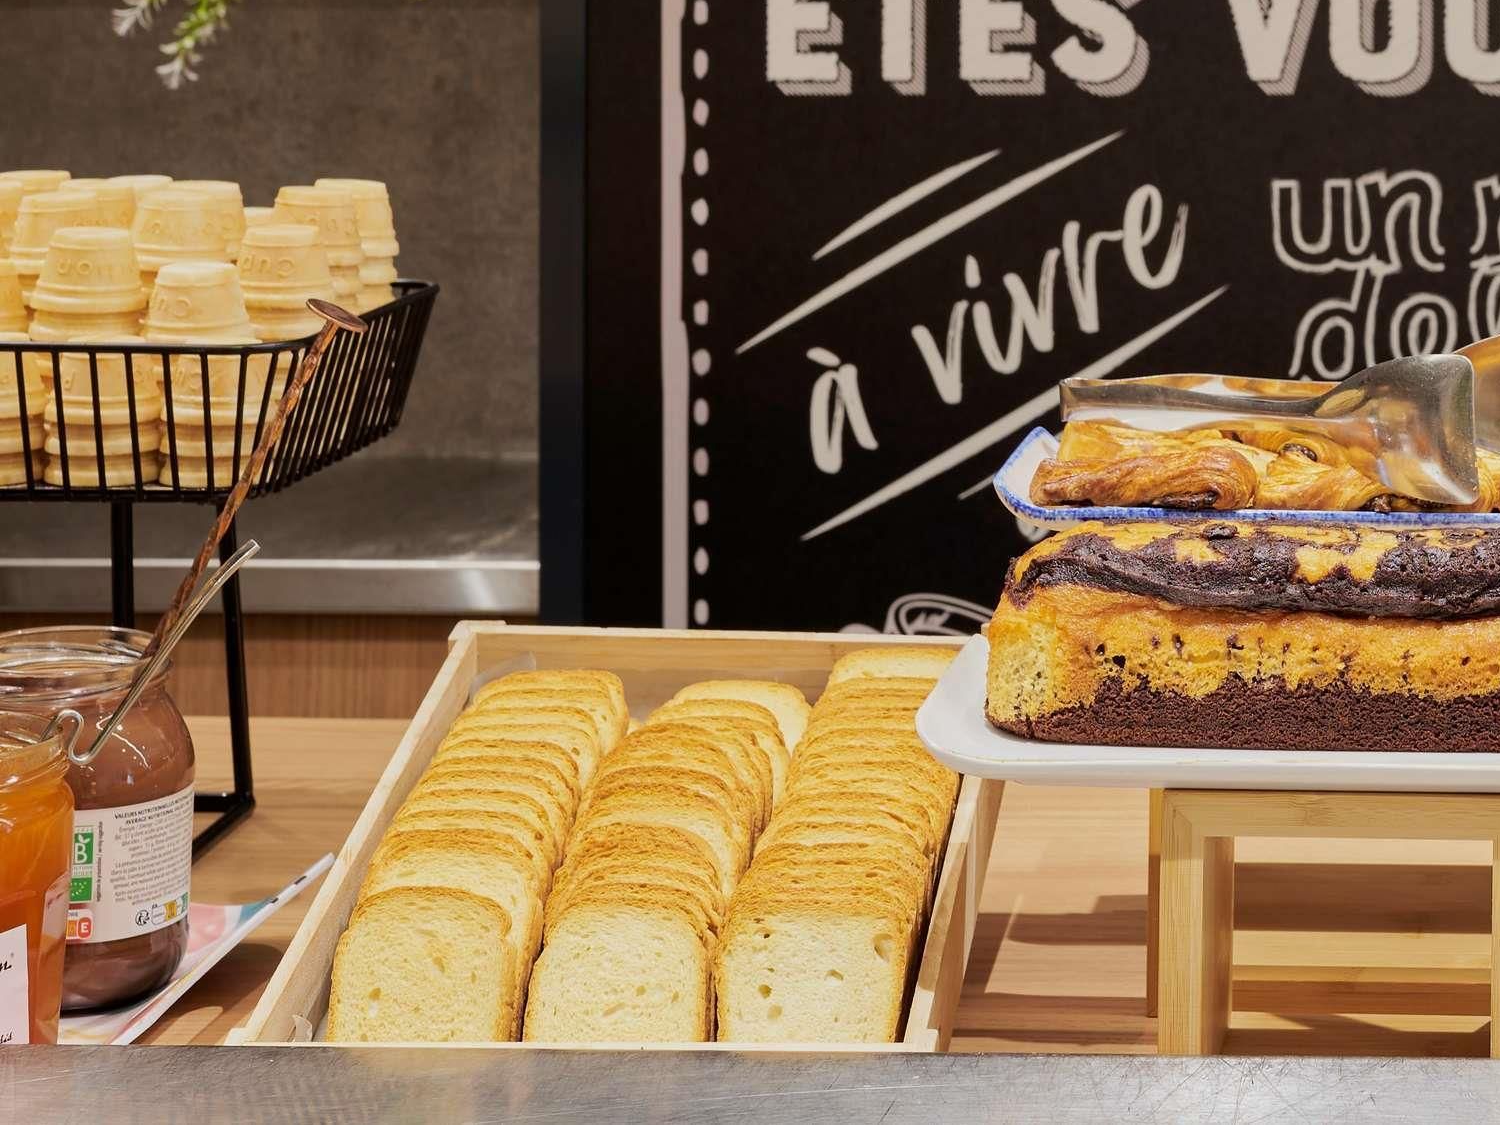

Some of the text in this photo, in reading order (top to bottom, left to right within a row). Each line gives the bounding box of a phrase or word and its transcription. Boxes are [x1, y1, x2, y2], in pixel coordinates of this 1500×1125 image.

[1271, 169, 1446, 273] un
[806, 184, 1190, 475] à vivre
